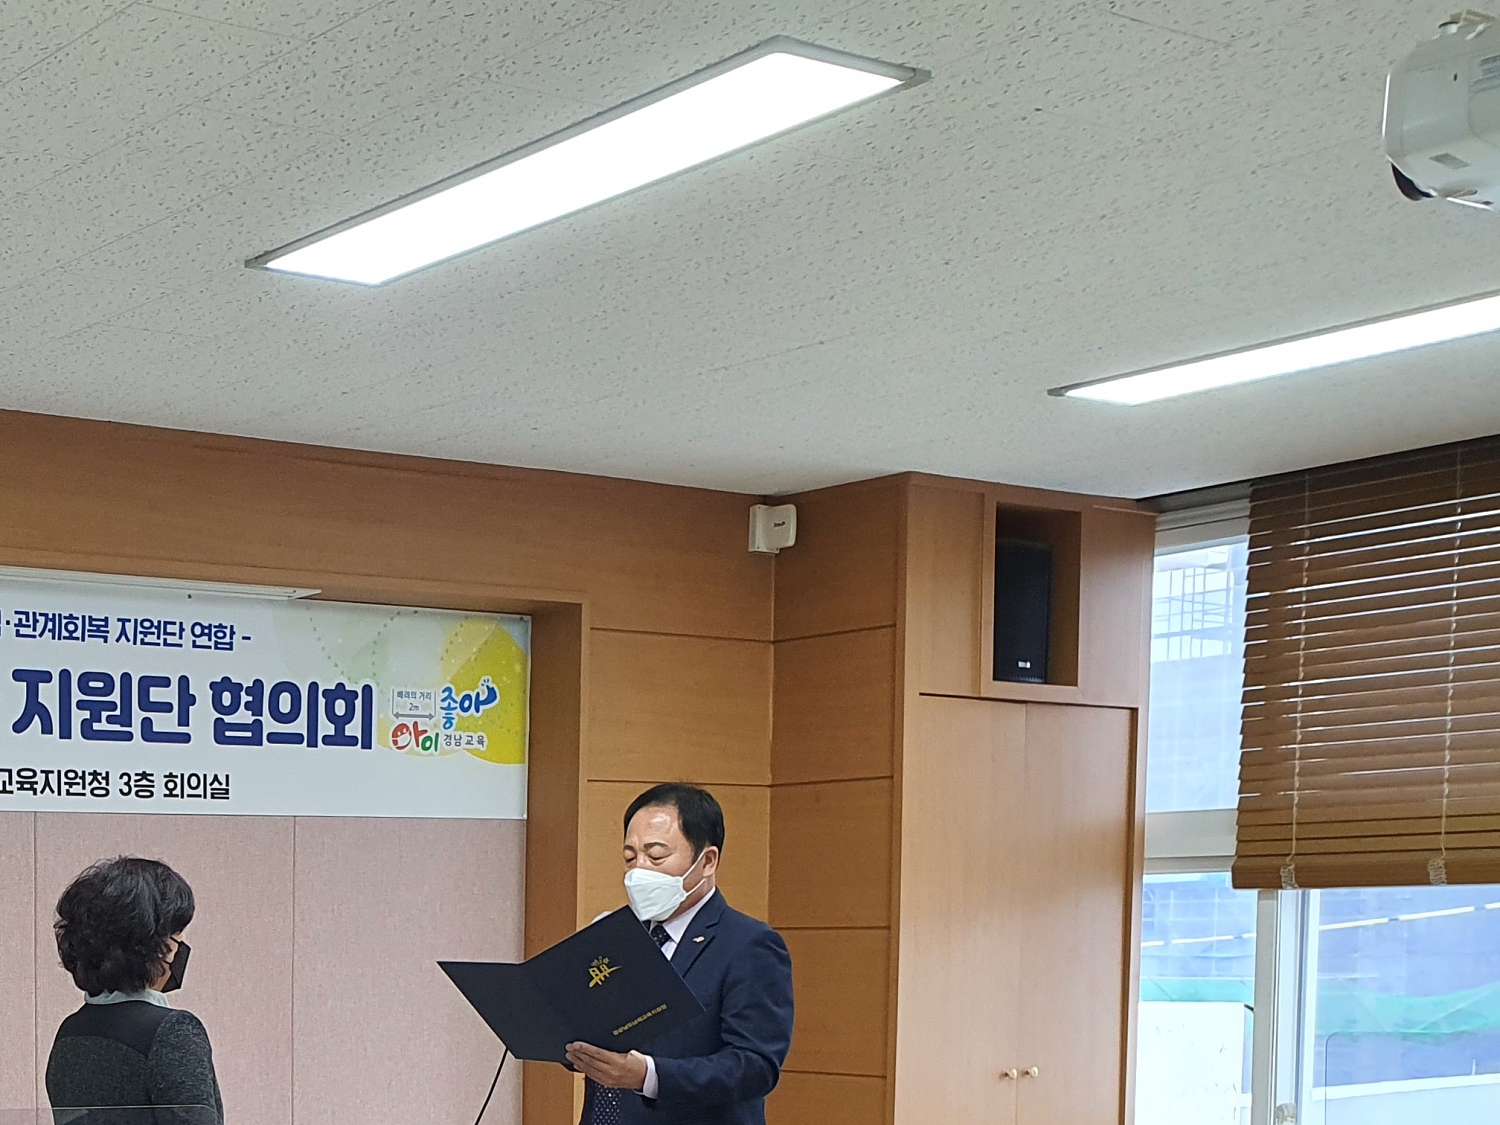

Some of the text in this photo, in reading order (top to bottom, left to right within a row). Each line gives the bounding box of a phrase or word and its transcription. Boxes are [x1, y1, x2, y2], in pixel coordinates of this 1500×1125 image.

[115, 617, 186, 649] 지원단
[190, 621, 236, 652] 연합
[11, 668, 197, 744] 지원단
[208, 675, 374, 751] 협의회
[408, 702, 420, 712] 2m
[118, 770, 156, 799] 3층
[162, 771, 231, 801] 회의실
